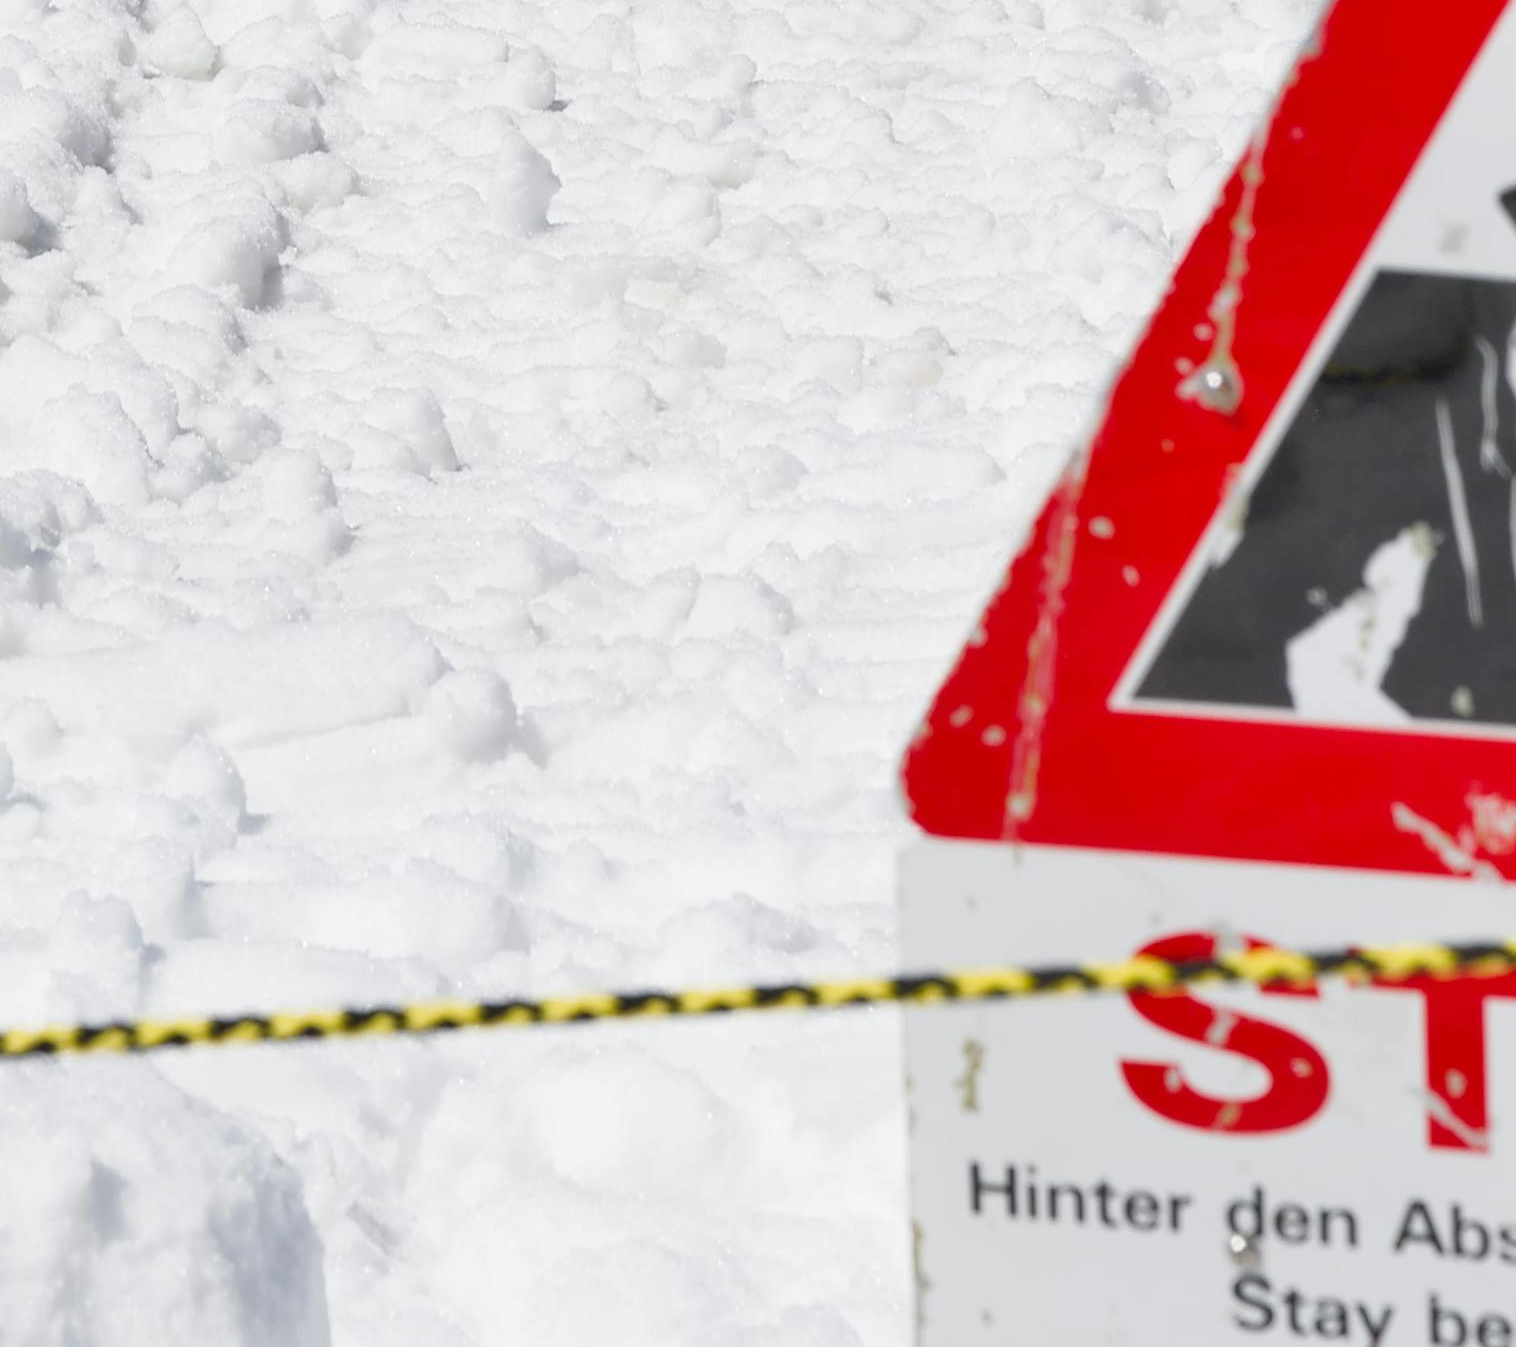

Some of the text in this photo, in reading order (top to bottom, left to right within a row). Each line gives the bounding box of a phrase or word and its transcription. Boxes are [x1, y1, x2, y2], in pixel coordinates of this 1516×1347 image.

[969, 1160, 1192, 1233] Hinter
[1226, 1184, 1359, 1248] den
[1230, 1272, 1393, 1347] Stay
